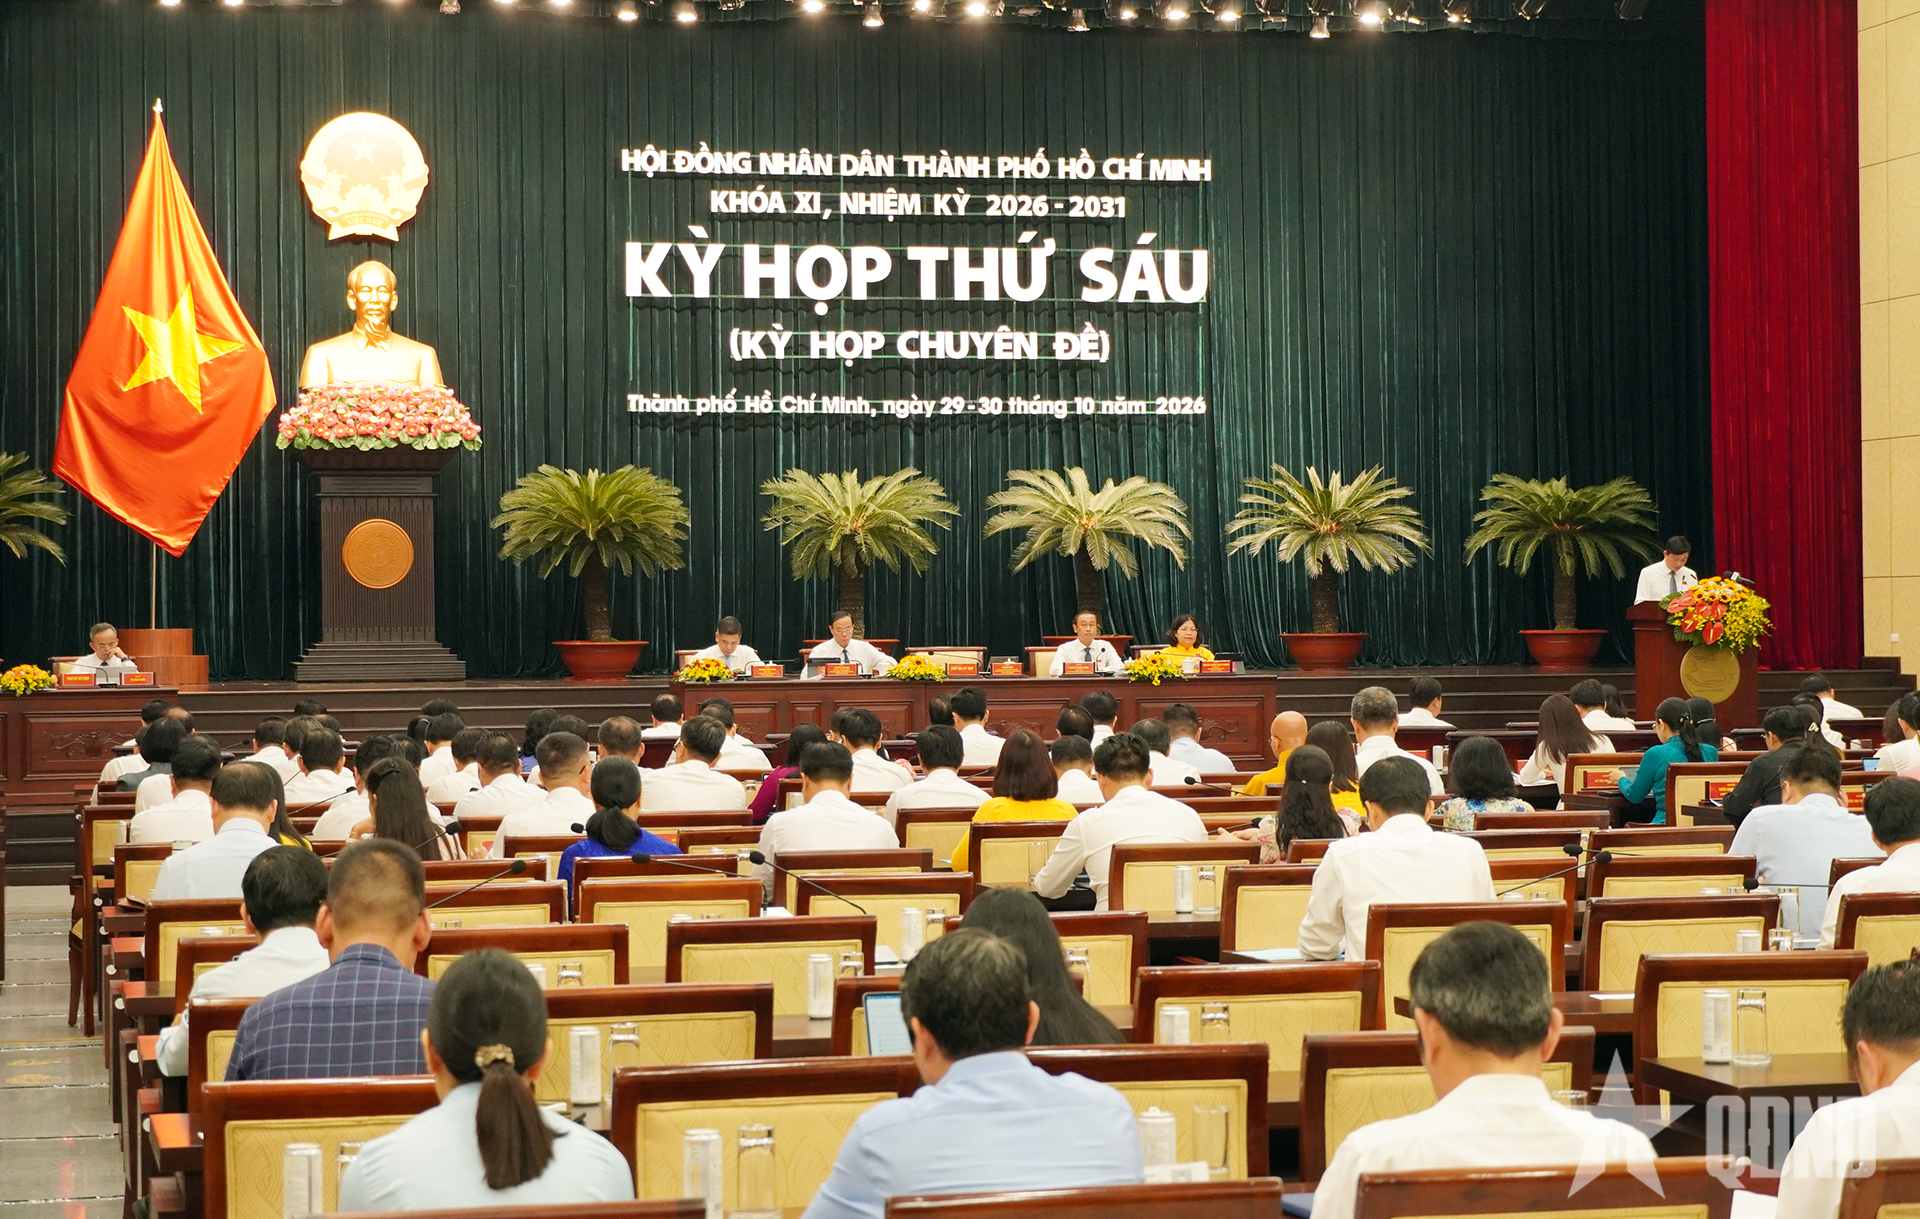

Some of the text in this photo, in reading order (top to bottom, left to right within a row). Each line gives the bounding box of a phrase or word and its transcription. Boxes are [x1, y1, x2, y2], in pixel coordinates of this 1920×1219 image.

[622, 142, 1212, 182] HỘI ĐỒNG NHÂN DÂN THÀNH PHỐ HỒ CHÍ MINH
[711, 185, 786, 214] KHÓA
[840, 187, 922, 222] NHIỆM
[933, 187, 971, 216] KỲ
[625, 225, 1209, 316] KỲ HỌP THỨ SÁU
[729, 322, 1110, 367] (KỲ HỌP CHUYÊN ĐỀ)
[627, 393, 690, 413] Thành
[696, 388, 737, 416] phố
[744, 390, 774, 413] Hồ
[779, 392, 816, 413] Chí
[822, 397, 877, 418] Minh,
[882, 394, 936, 419] ngày
[1009, 394, 1068, 419] tháng
[1073, 397, 1095, 415] 10
[1101, 396, 1147, 415] năm
[1155, 397, 1207, 415] 2026
